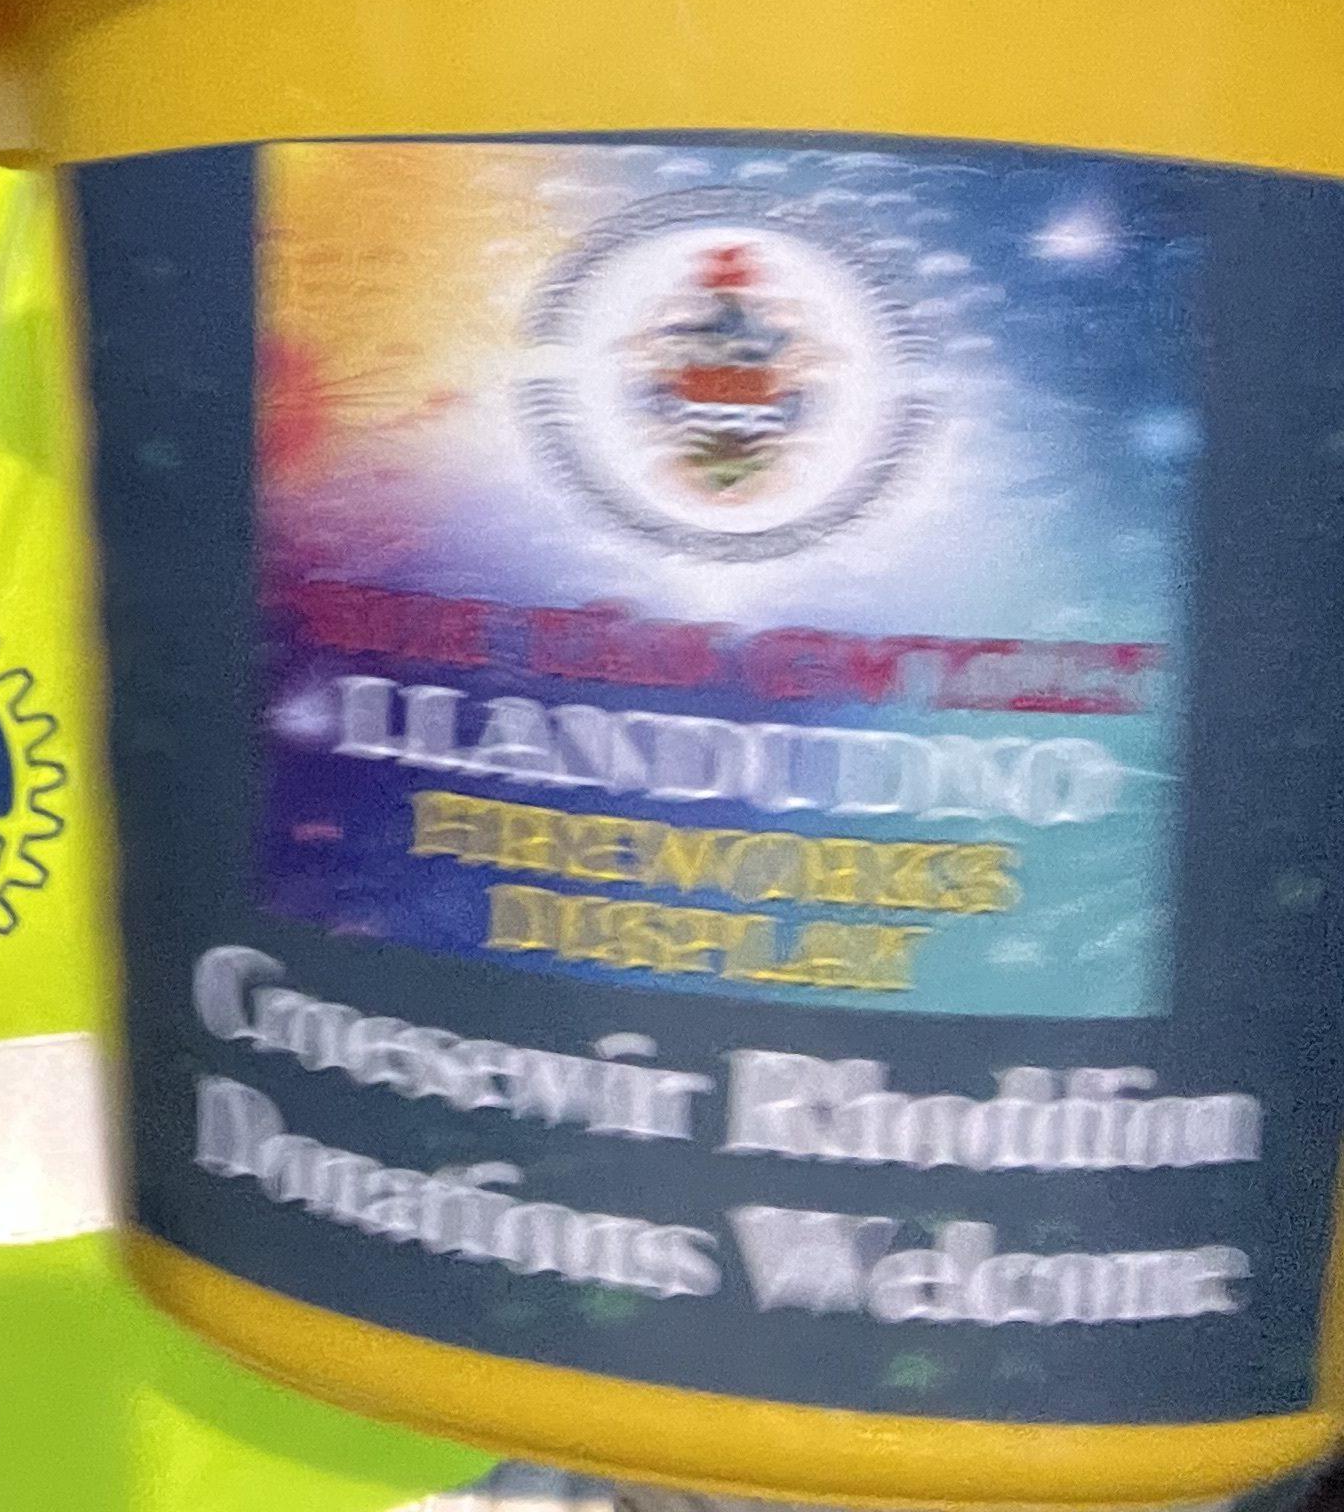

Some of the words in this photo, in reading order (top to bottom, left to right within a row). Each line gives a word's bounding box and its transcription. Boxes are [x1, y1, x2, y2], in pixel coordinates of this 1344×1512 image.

[332, 674, 1118, 826] LLANDUDNO
[193, 1075, 722, 1299] Donations
[726, 1205, 1254, 1325] Welcome
